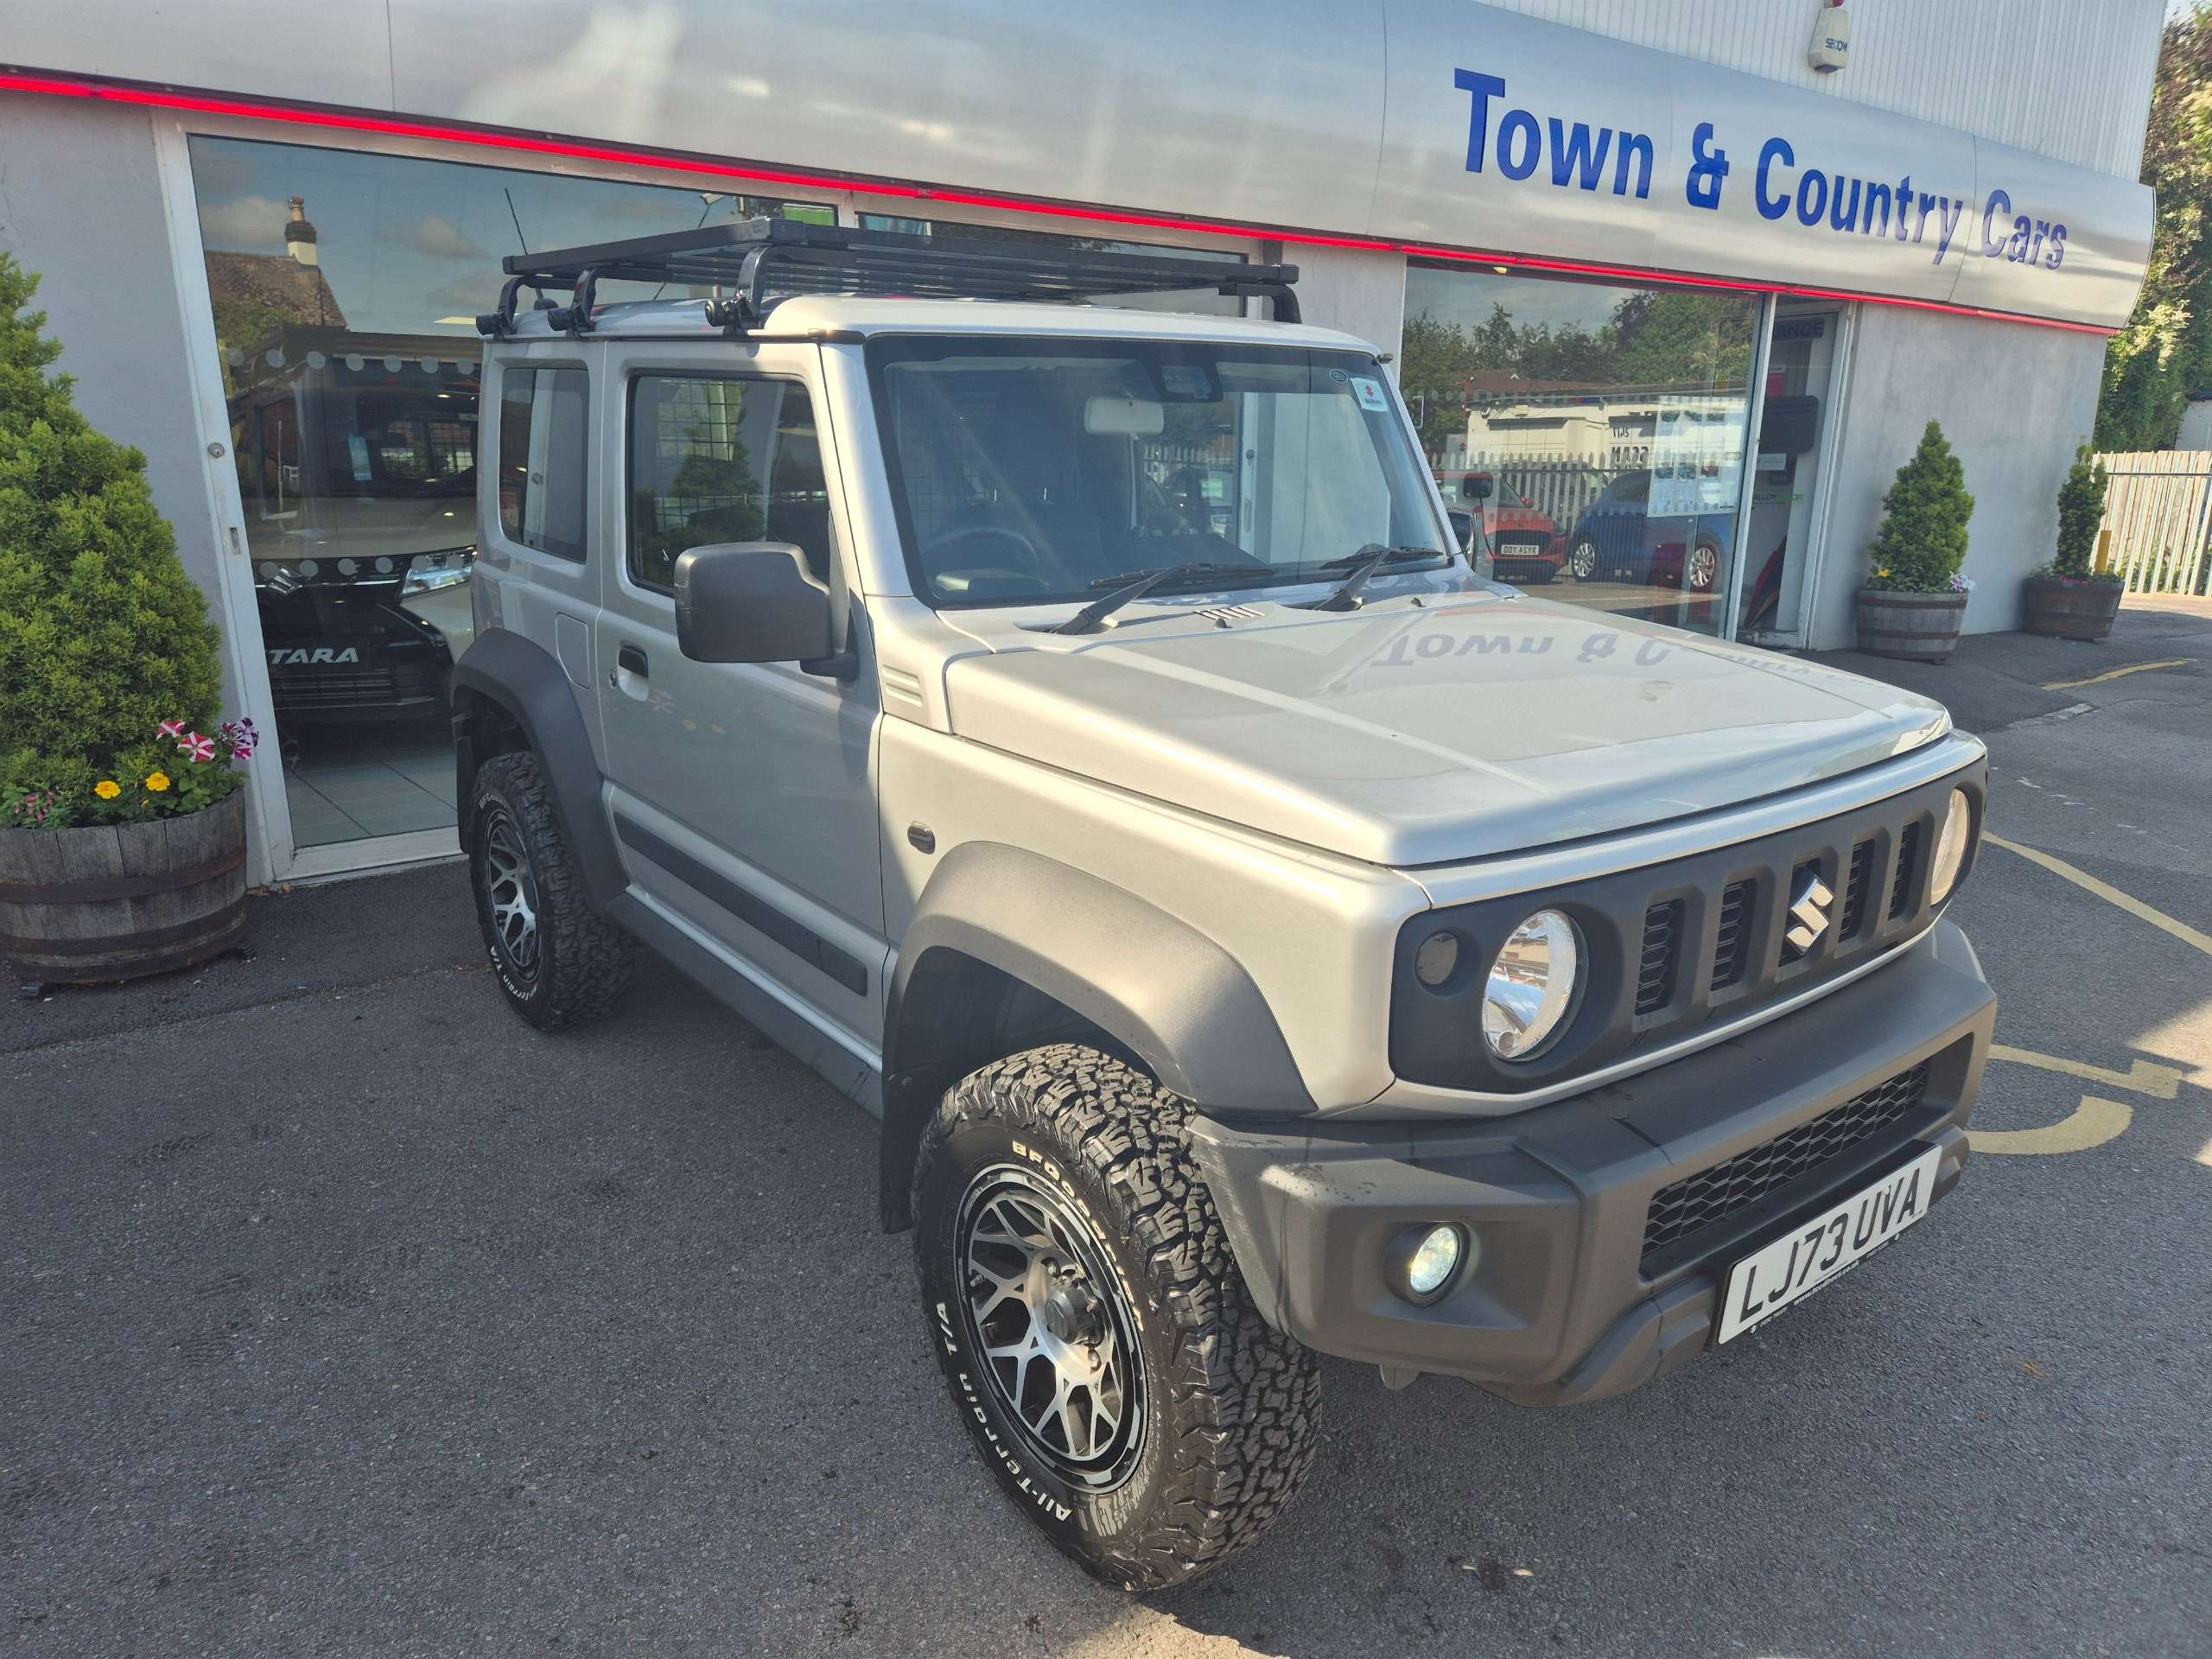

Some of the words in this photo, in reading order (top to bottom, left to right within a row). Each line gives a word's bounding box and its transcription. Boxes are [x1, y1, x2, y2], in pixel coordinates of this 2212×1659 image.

[1454, 68, 1655, 200] Town
[1686, 123, 1729, 210] &
[1755, 137, 1963, 266] Country
[1982, 190, 2068, 271] Cars
[1739, 1212, 1849, 1323] LJ73
[1853, 1167, 1921, 1251] UVA
[936, 1302, 957, 1356] T/A
